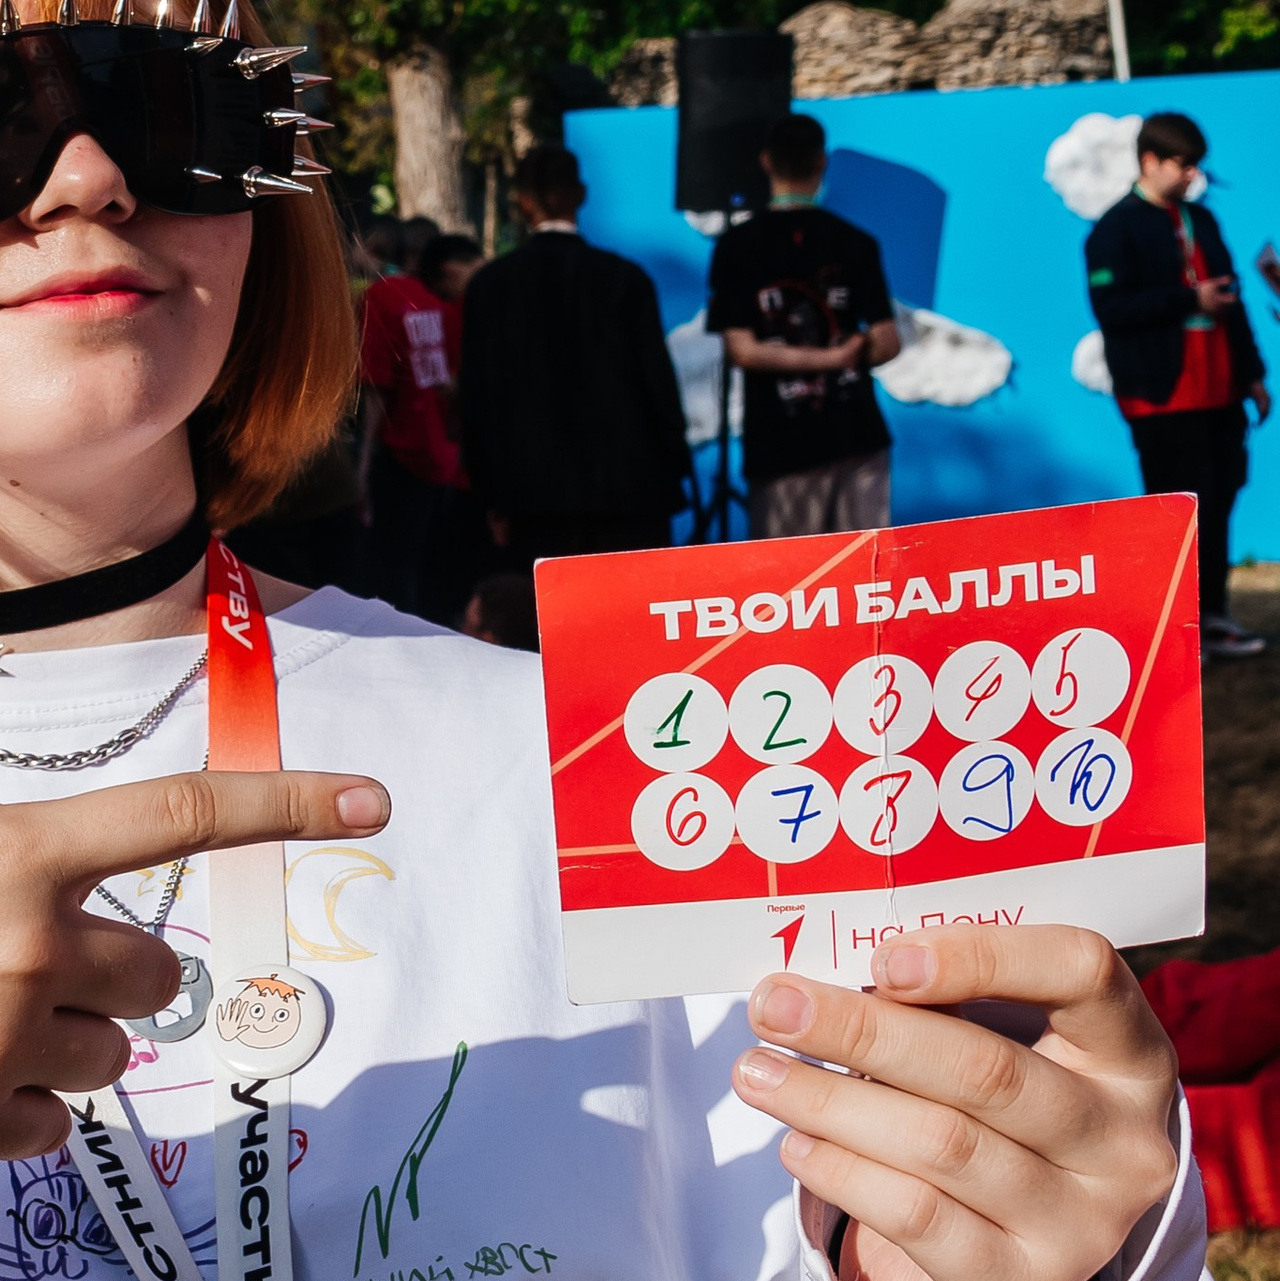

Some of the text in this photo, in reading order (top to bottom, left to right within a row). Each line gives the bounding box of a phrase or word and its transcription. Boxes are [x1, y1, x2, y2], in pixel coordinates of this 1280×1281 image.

[650, 554, 1097, 641] ТВОИ БАЛЛЫ
[652, 632, 1083, 751] 1 2 3 4 5
[665, 786, 708, 847] 6
[771, 783, 822, 844] 7
[863, 769, 913, 847] 8
[962, 753, 1015, 833] 9
[766, 902, 807, 915] Первые
